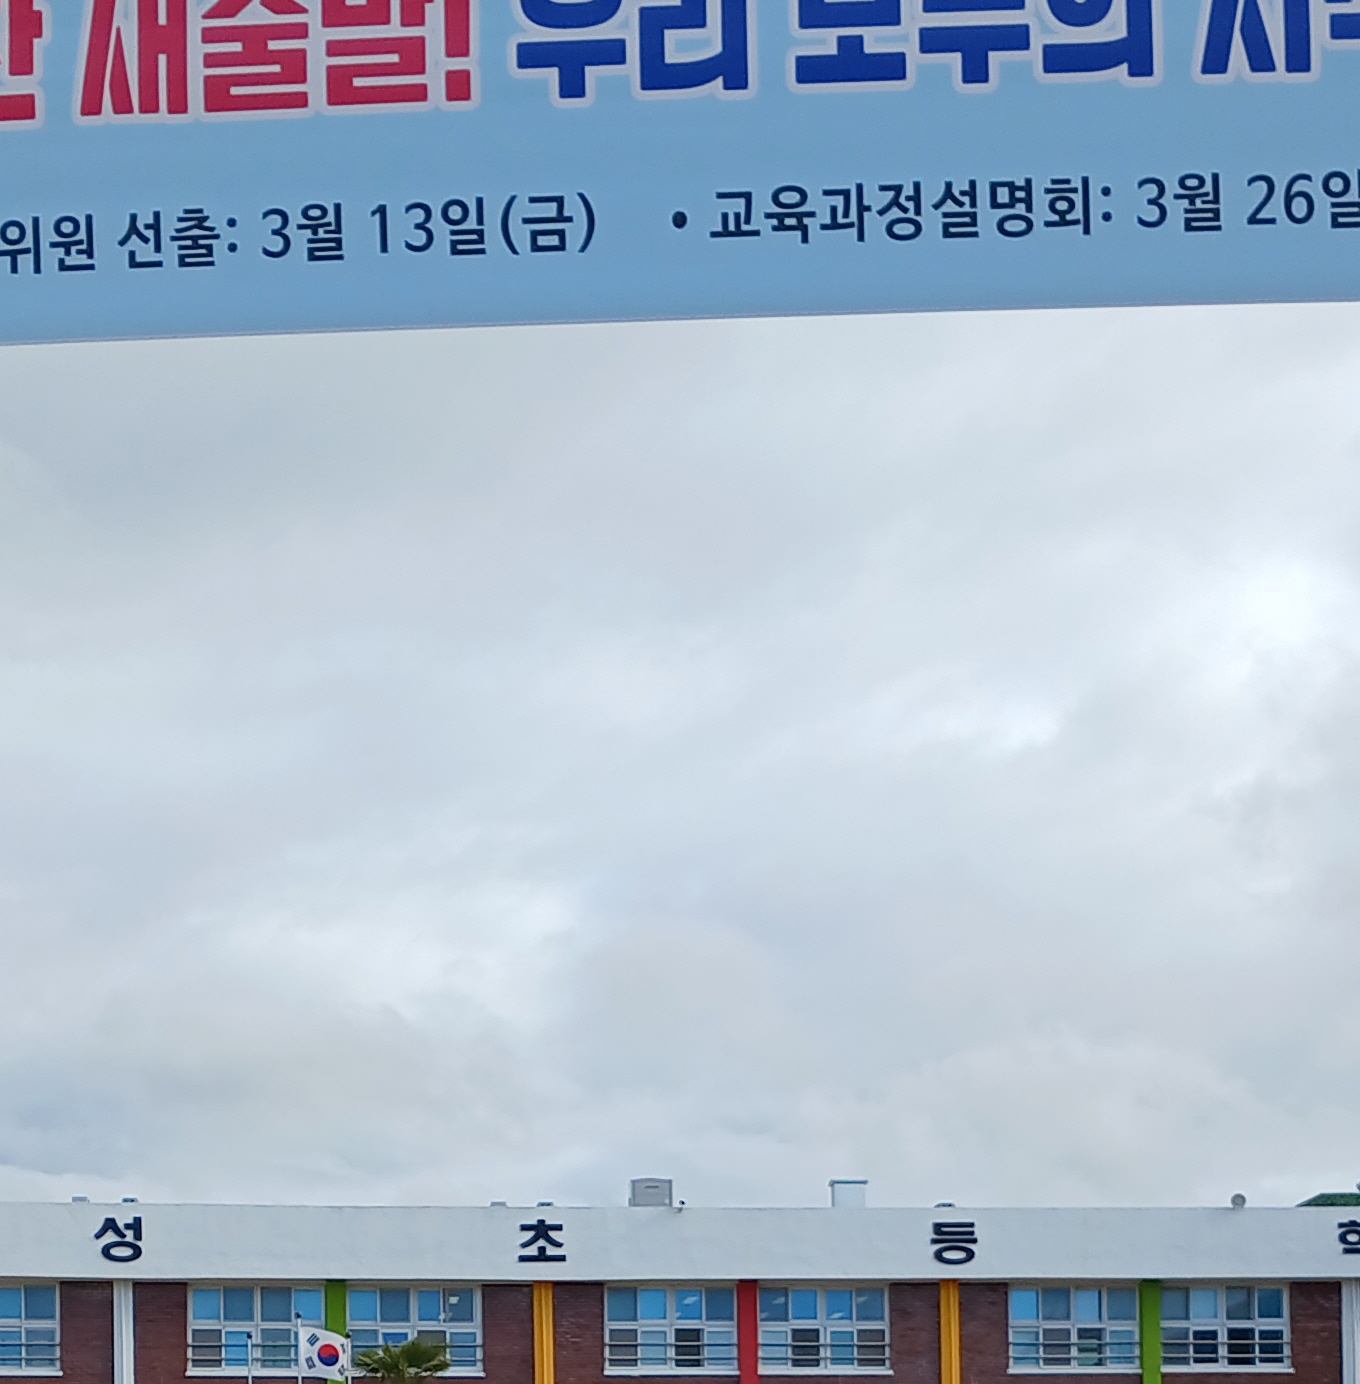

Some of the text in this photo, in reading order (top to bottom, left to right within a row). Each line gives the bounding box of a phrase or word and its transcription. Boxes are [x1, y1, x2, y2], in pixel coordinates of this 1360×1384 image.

[117, 206, 239, 270] 선출:
[259, 200, 346, 263] 3월
[369, 189, 598, 257] 13일(금)
[708, 173, 1114, 245] 교육과정설명회:
[1134, 168, 1223, 232] 3월
[94, 1216, 144, 1263] 성
[517, 1218, 567, 1263] 초
[930, 1220, 979, 1265] 등
